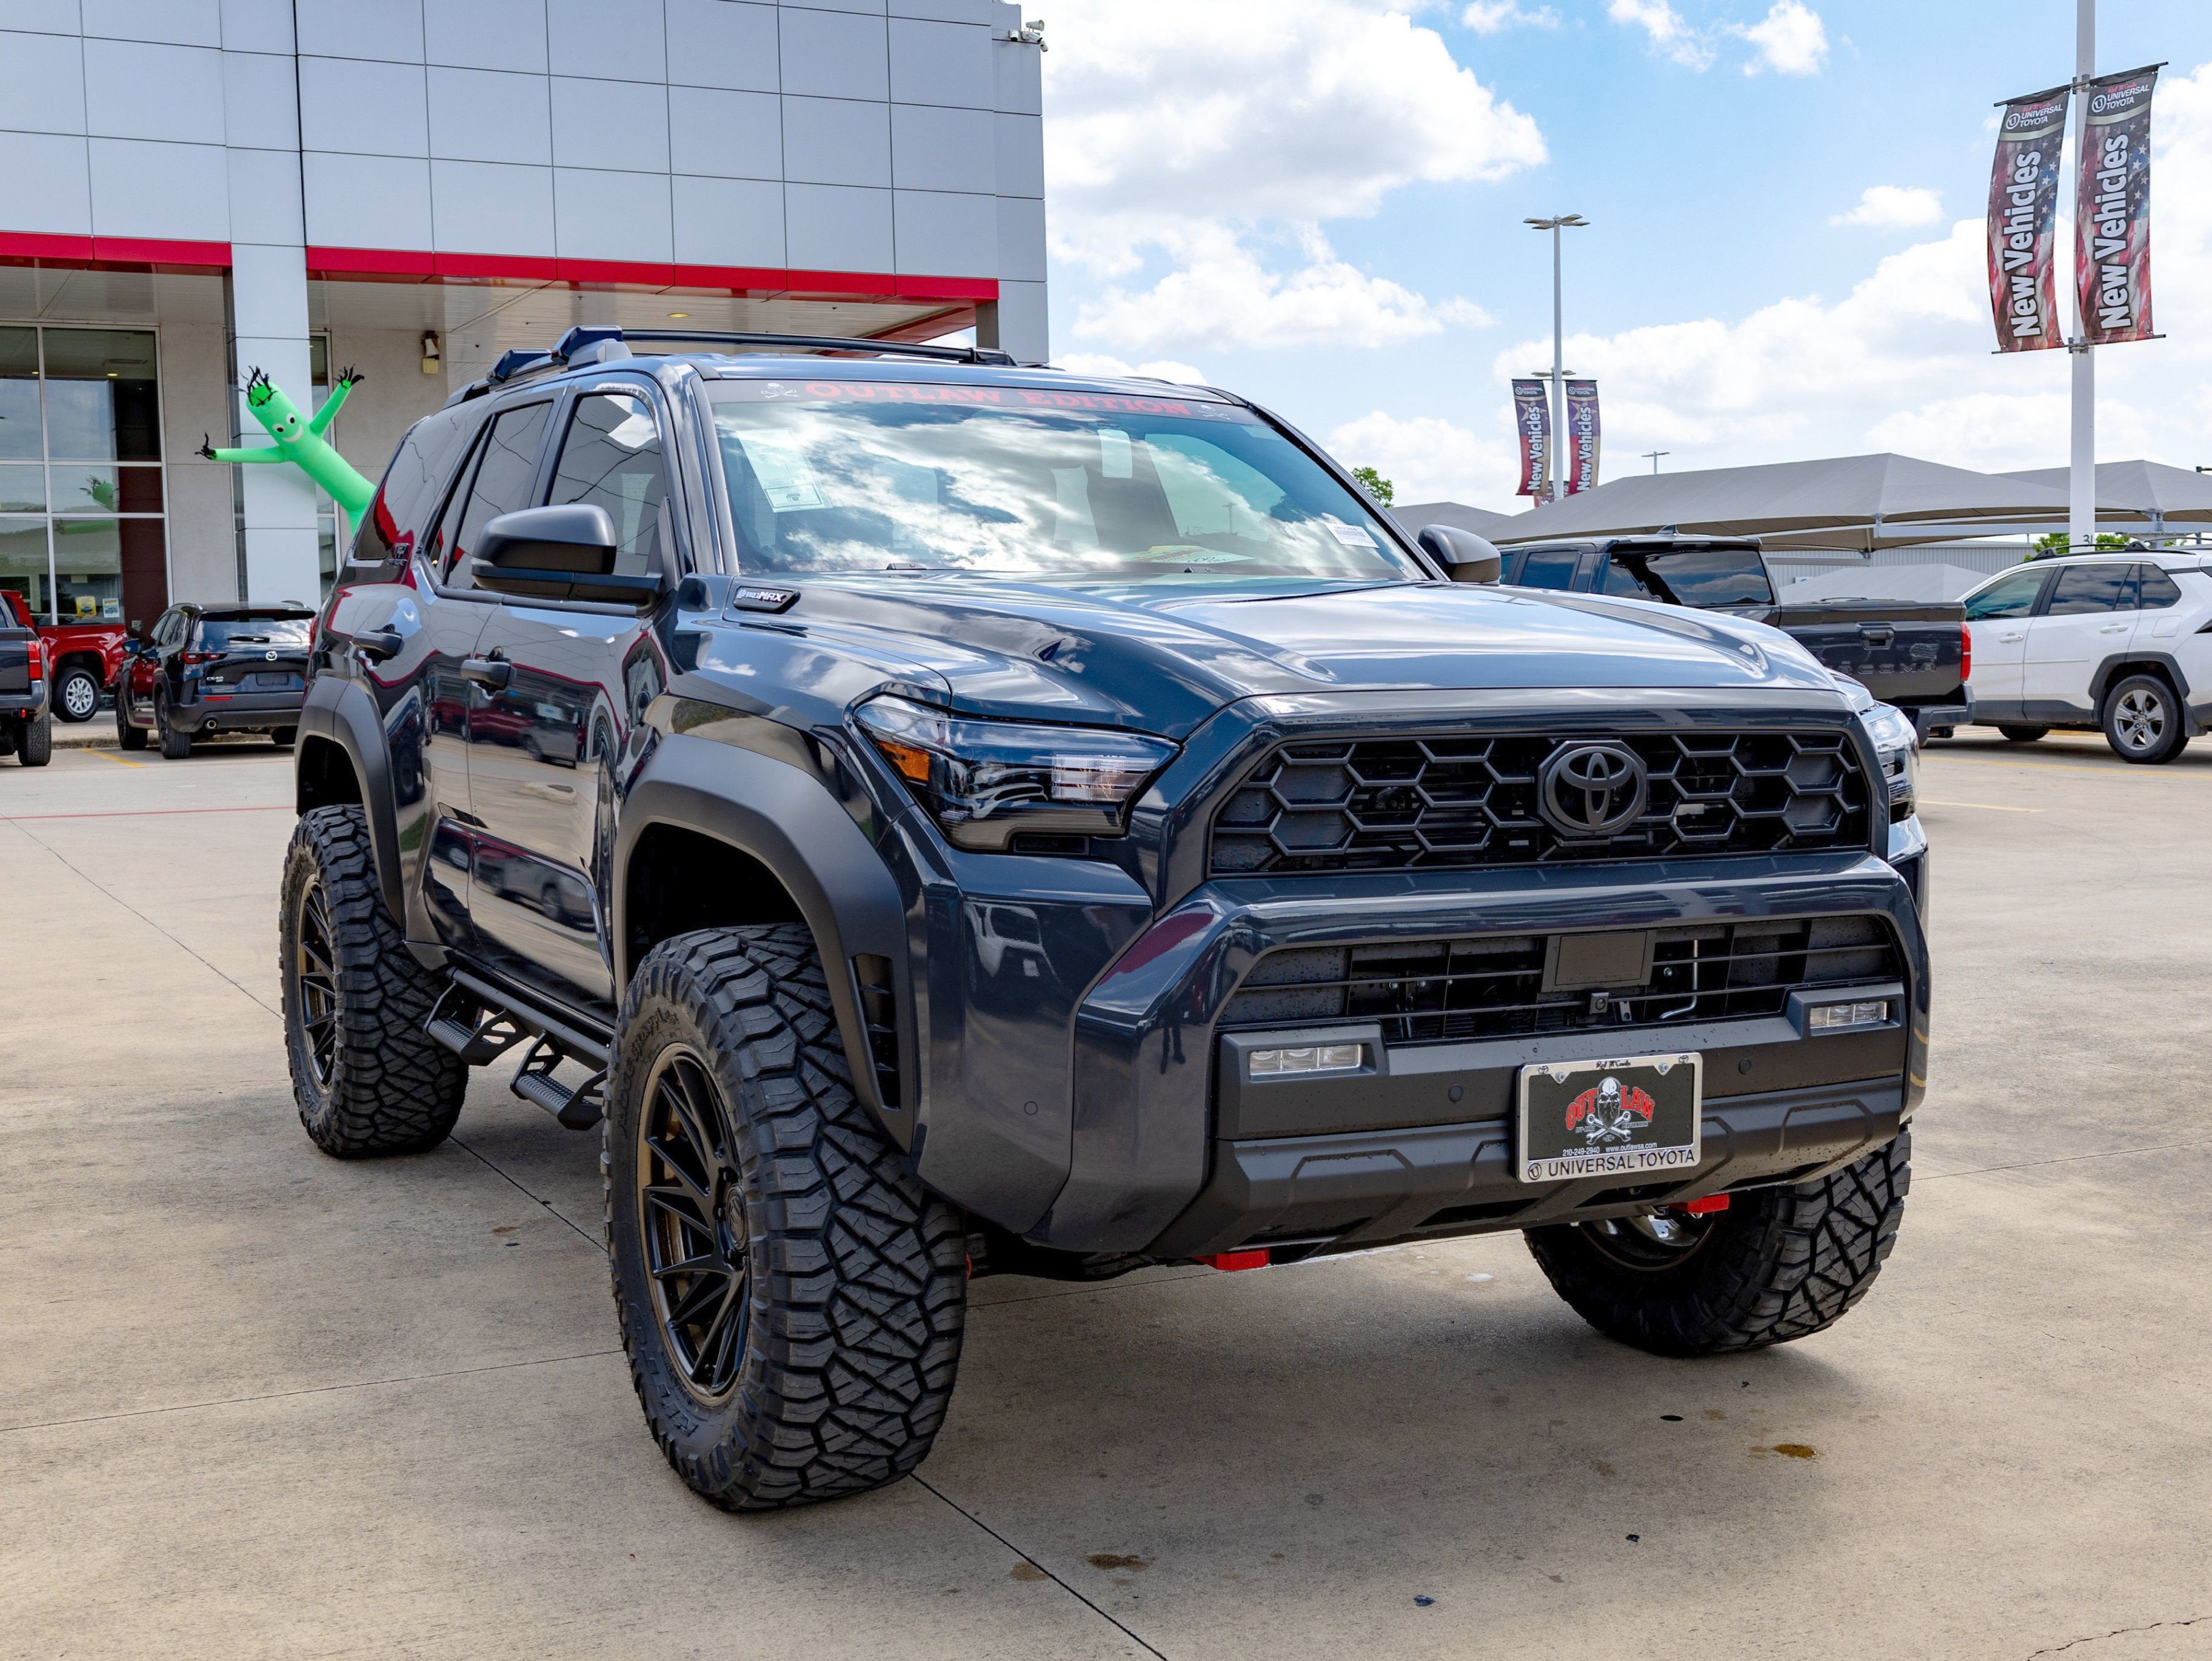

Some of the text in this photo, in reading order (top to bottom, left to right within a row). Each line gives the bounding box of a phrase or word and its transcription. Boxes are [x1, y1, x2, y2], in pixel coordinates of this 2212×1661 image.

[2107, 84, 2150, 101] UNIVERSAL
[2107, 96, 2134, 109] TOYOTA
[2020, 116, 2048, 127] TOYOTA
[2022, 104, 2063, 119] UNIVERSAL
[2004, 150, 2042, 337] New Vehicles
[2094, 133, 2132, 329] New Vehicles
[804, 383, 1192, 416] OUTLAW EDITION
[1526, 406, 1543, 460] Vehicles
[1577, 407, 1592, 492] New Vehicles
[1526, 462, 1543, 490] New
[1829, 661, 1937, 675] ACOMA
[1548, 1149, 1695, 1176] UNIVERSAL TOYOTA
[1562, 1142, 1657, 1157] 210-249-2940 www.outlawsa.com
